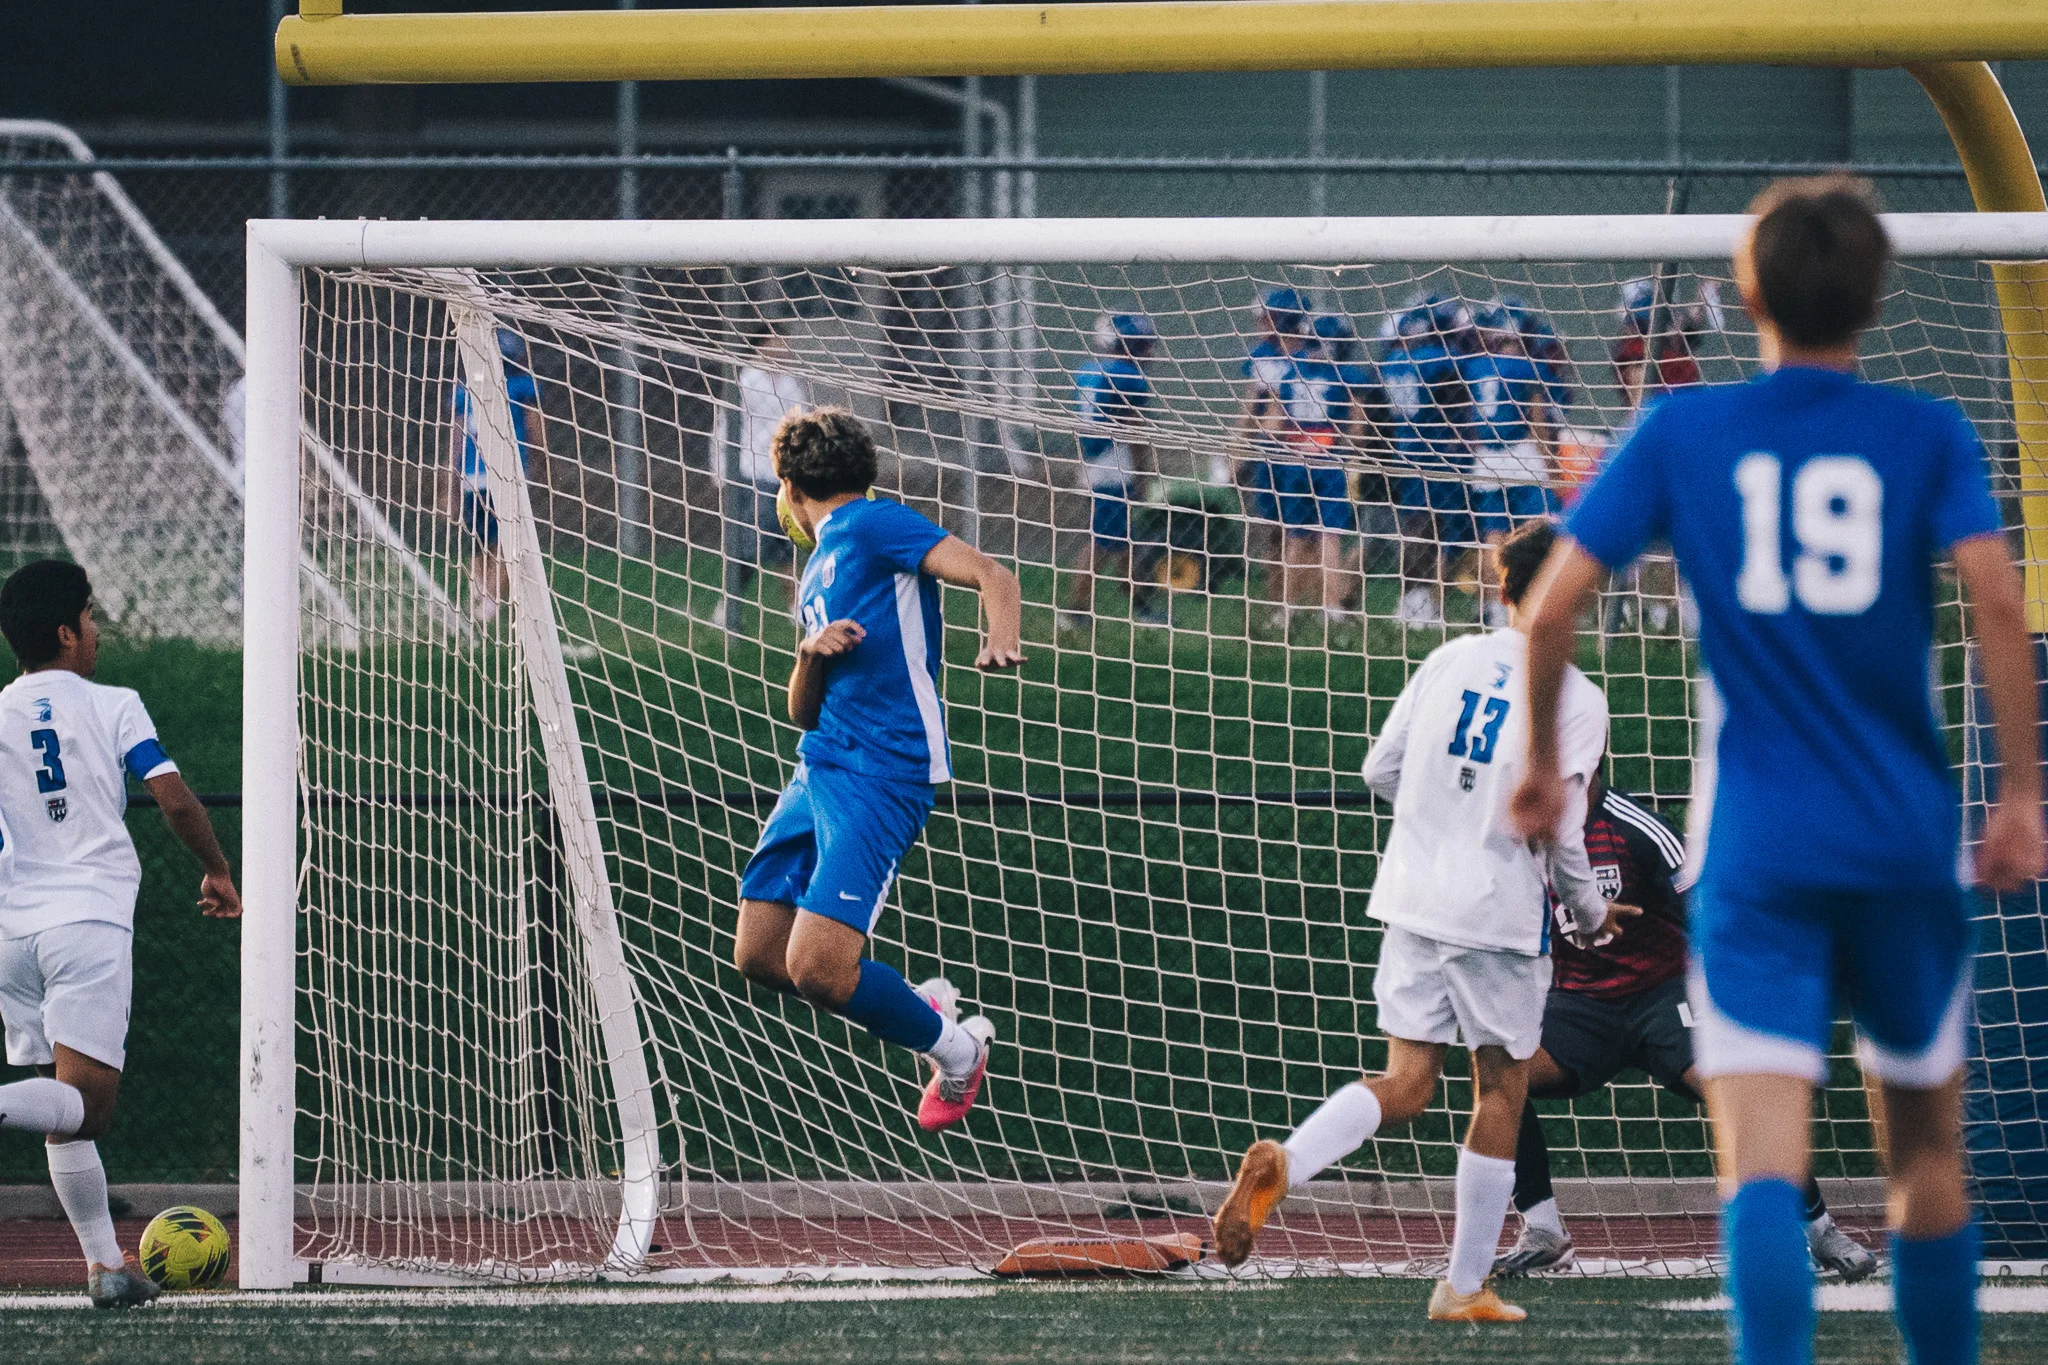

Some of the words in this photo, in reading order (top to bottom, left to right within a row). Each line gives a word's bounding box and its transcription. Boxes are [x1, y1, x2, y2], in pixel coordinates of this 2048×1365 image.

[1734, 452, 1882, 615] 19
[31, 728, 67, 794] 3
[1448, 689, 1510, 764] 13
